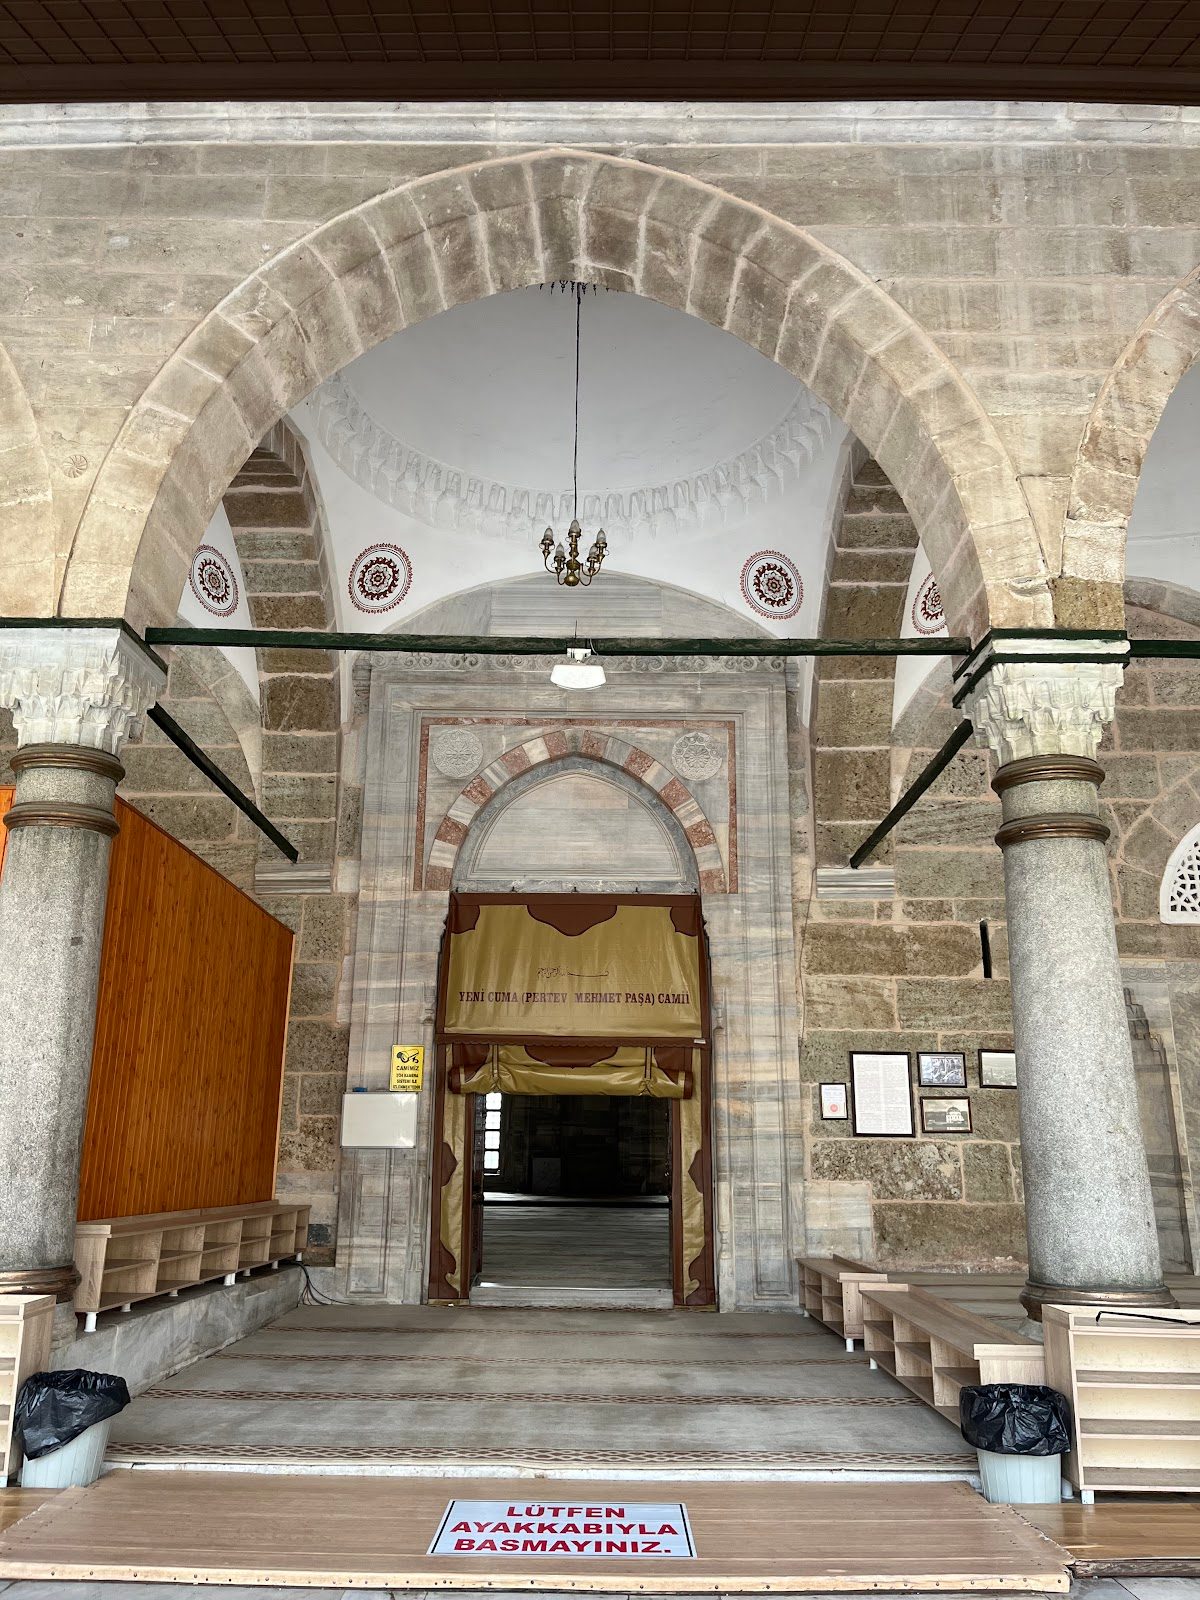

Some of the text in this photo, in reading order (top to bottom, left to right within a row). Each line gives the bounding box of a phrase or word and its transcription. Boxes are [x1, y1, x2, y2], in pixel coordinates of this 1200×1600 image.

[459, 988, 485, 1002] YENİ
[487, 991, 518, 1003] CUMA
[521, 992, 568, 1004] (PERTEV
[574, 992, 621, 1004] MEHMET
[625, 993, 655, 1006] PAŞA)
[506, 1504, 625, 1518] LÜTFEN
[450, 1522, 678, 1535] AYAKKABIYLA
[454, 1539, 671, 1554] BASMAYINIZ.
